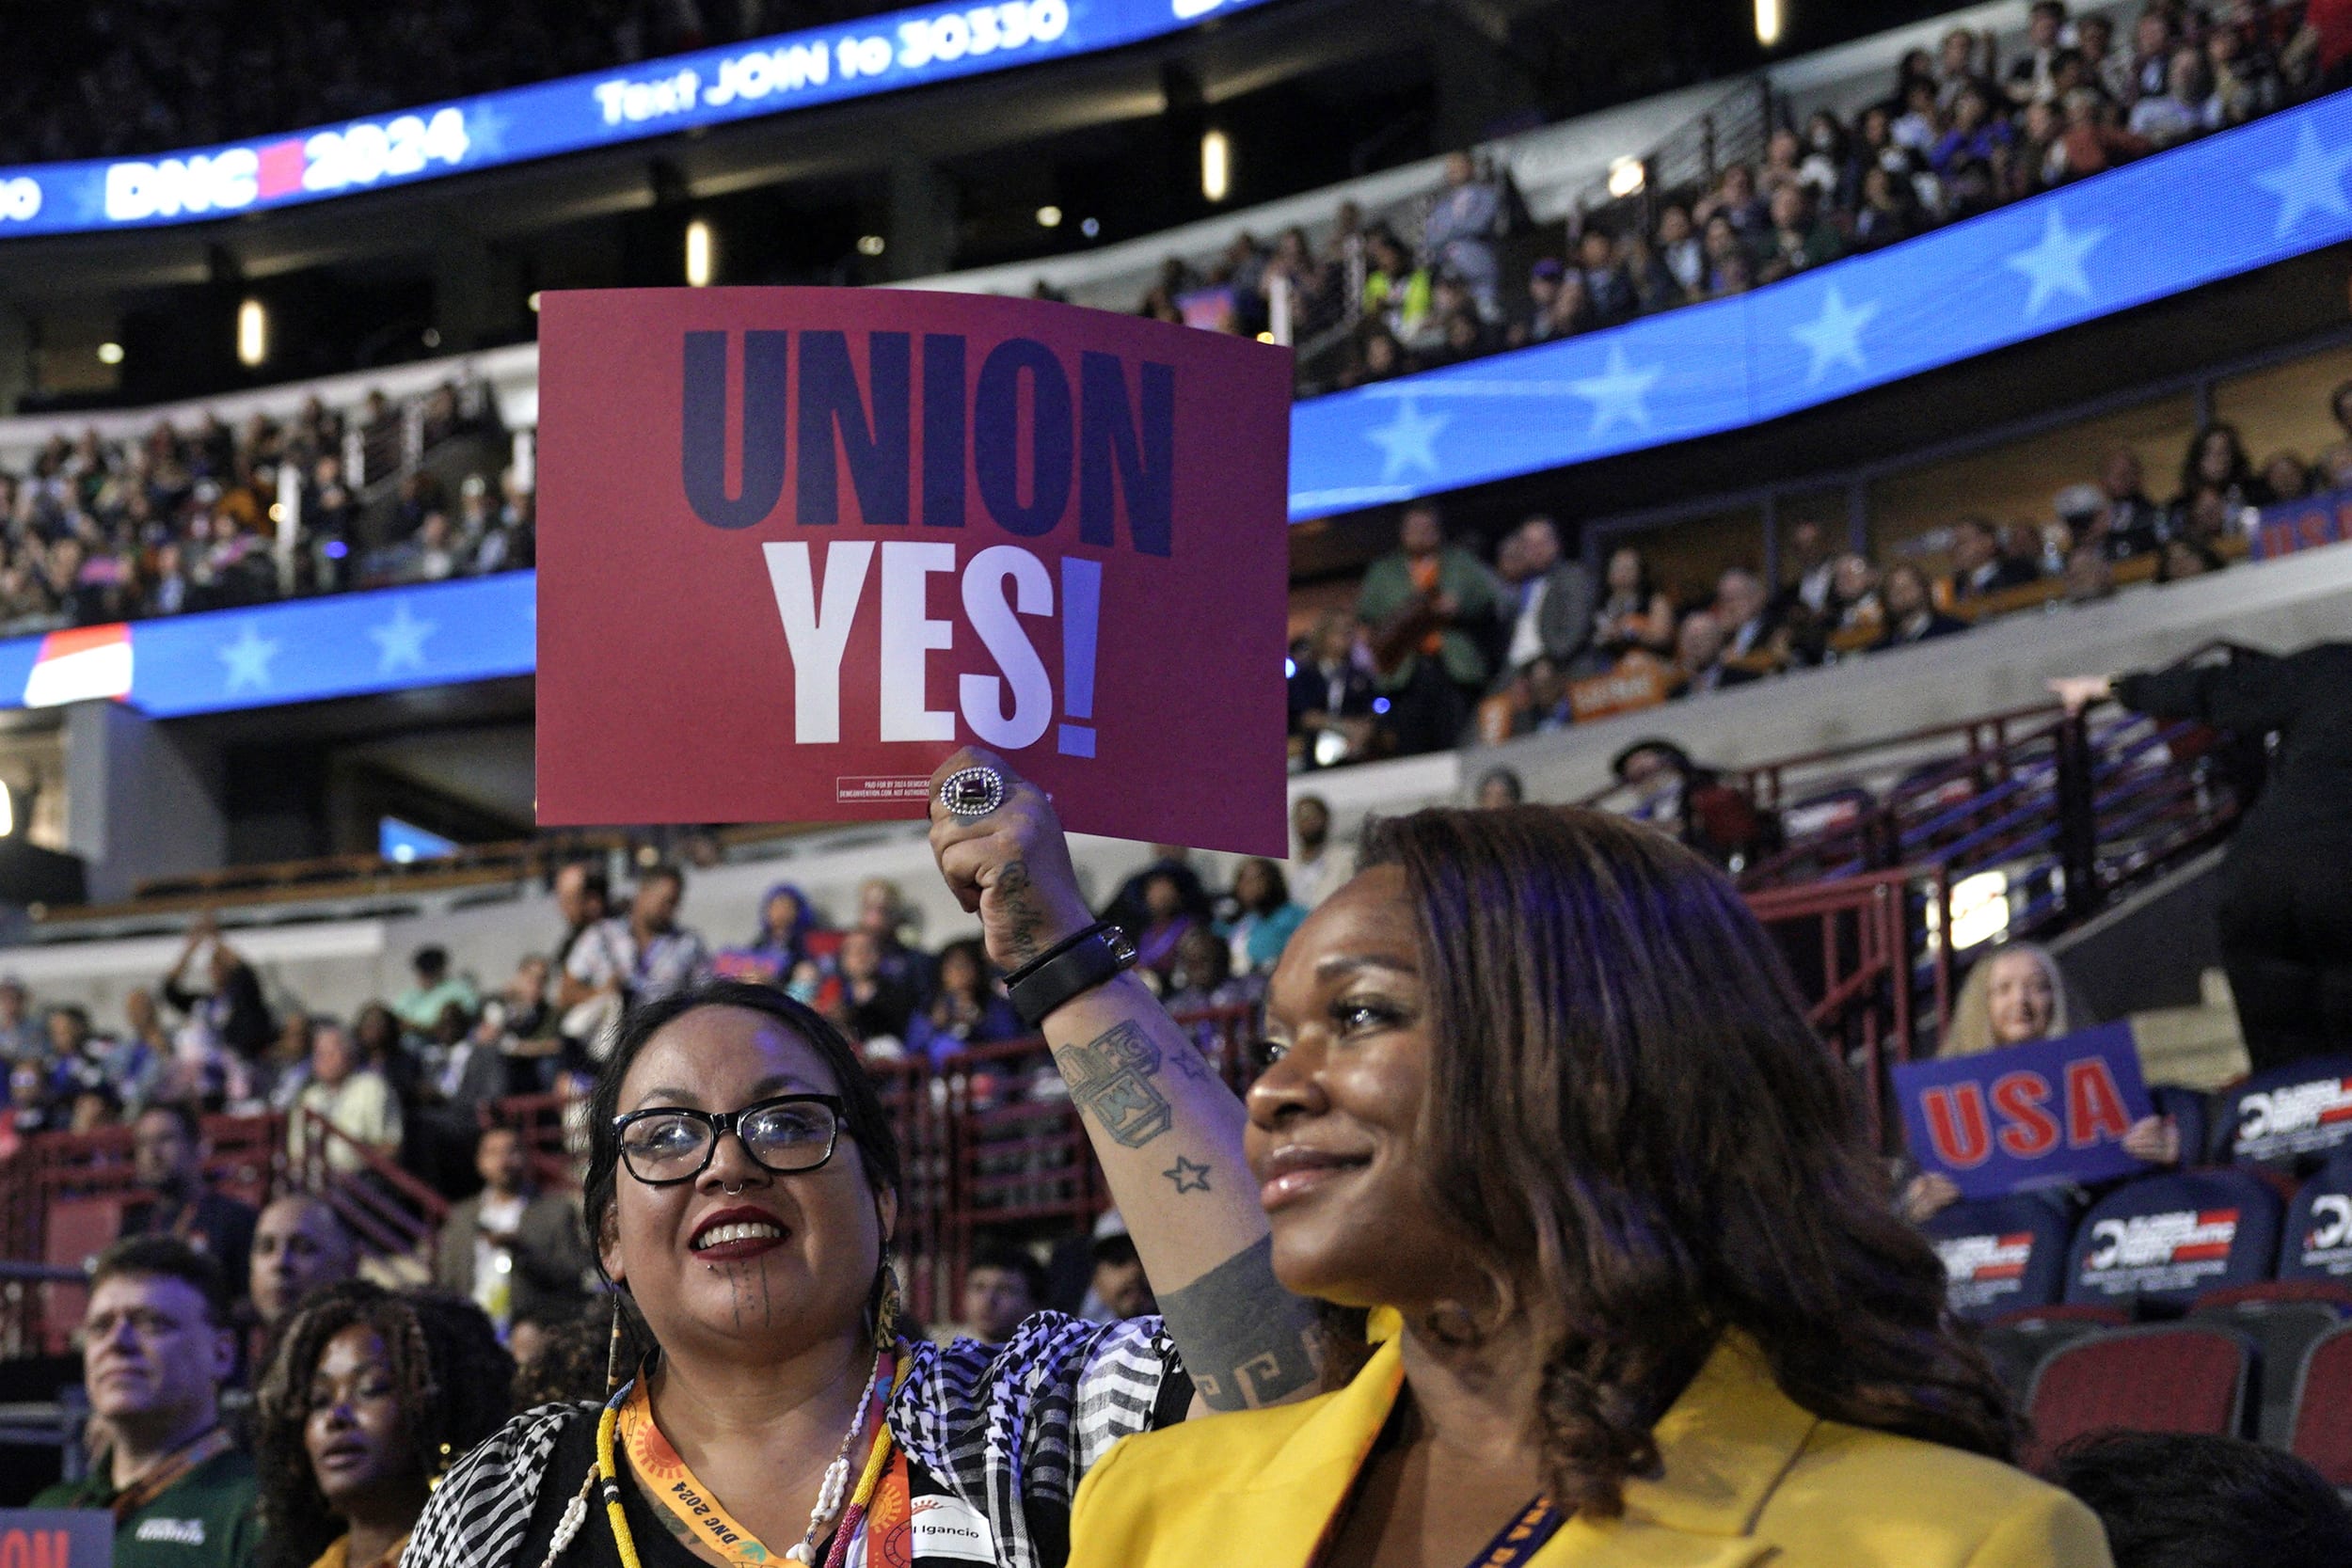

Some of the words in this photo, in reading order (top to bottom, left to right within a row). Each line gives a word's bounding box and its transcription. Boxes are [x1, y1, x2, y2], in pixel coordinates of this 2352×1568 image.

[595, 70, 699, 125] Text
[704, 40, 830, 106] JOIN
[836, 37, 893, 78] to
[898, 0, 1070, 68] 30330
[104, 148, 260, 221] DNC
[302, 107, 470, 191] 2024
[682, 329, 1174, 558] UNION
[761, 540, 1102, 758] YES!
[1919, 1054, 2134, 1170] USA
[671, 1481, 710, 1516] 2024
[703, 1517, 739, 1544] DNC
[921, 1524, 980, 1539] Igancio
